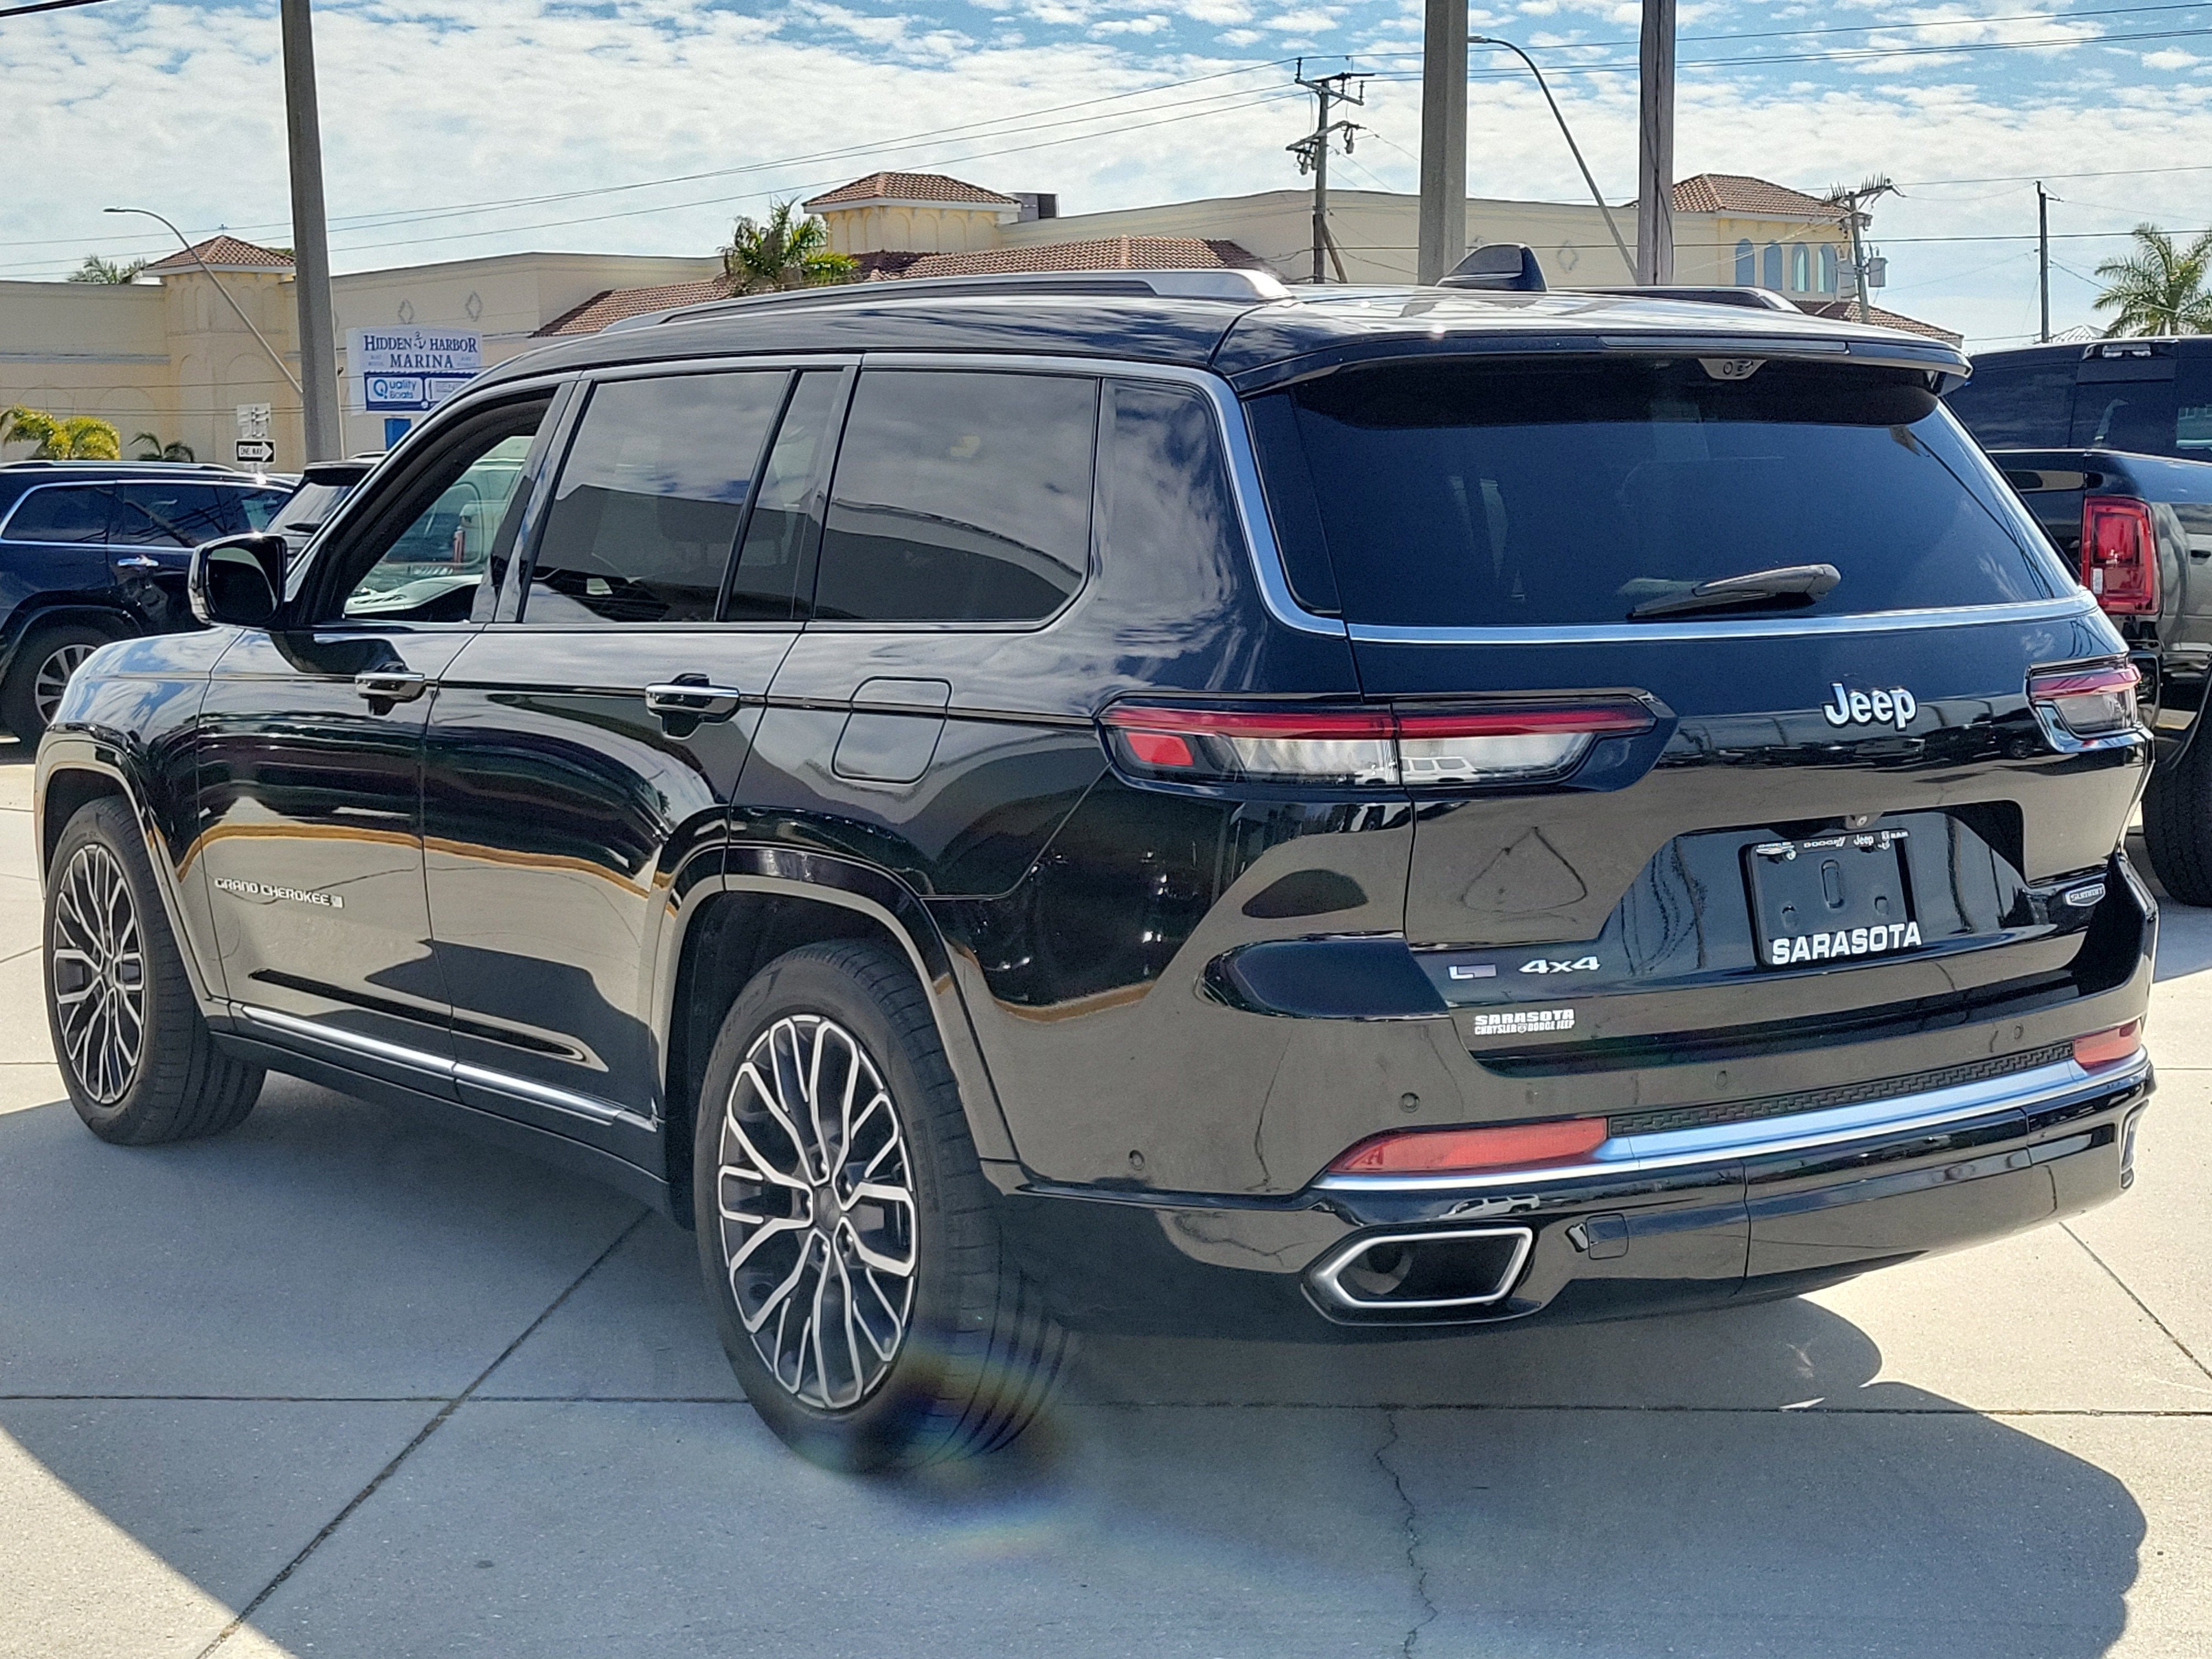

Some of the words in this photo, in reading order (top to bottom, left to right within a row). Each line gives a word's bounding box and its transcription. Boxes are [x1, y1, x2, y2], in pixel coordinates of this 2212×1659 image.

[364, 335, 411, 351] HIDDEN
[430, 337, 477, 352] HARBOR
[390, 354, 453, 368] MARINA
[373, 379, 416, 399] Quality
[1824, 682, 1916, 729] Jeep
[215, 878, 258, 894] GRAND
[261, 884, 331, 906] CHEROKEE
[1771, 921, 1922, 965] SARASOTA
[1517, 956, 1601, 974] 4x4
[1474, 1008, 1575, 1026] SARASOTA
